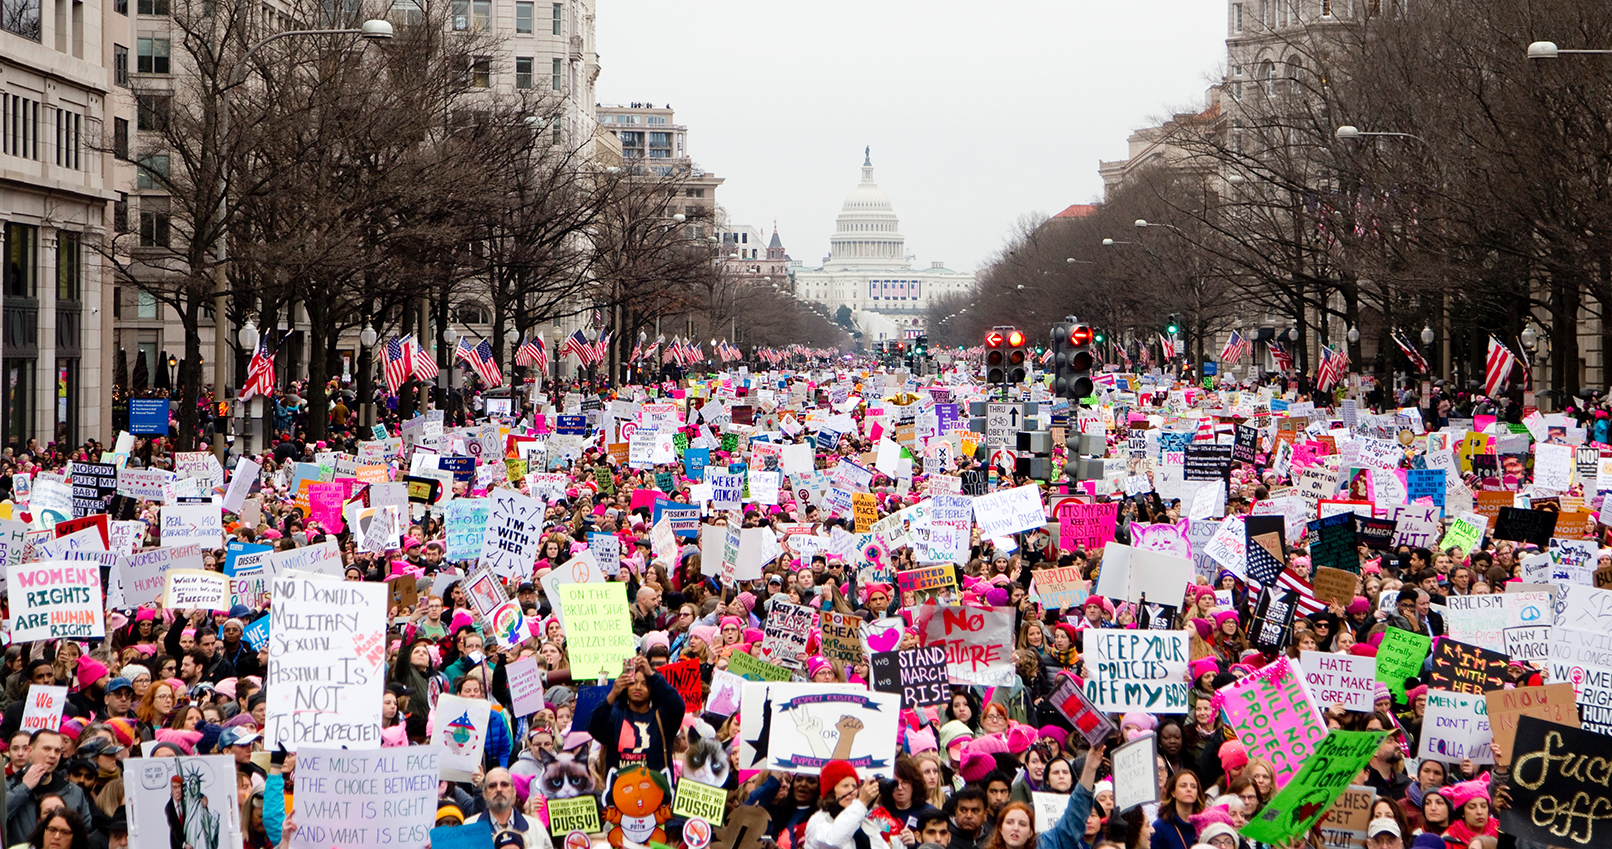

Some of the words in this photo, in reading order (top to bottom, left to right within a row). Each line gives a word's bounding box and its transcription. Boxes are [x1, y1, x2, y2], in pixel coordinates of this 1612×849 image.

[988, 428, 1005, 436] OBEY
[1129, 440, 1145, 449] LIVES
[1234, 443, 1255, 453] OVARY
[176, 452, 207, 462] NASTY
[1234, 451, 1254, 461] ACTION
[1360, 454, 1395, 469] TREASON
[1431, 454, 1448, 465] YES
[1577, 449, 1598, 463] NO!
[73, 464, 114, 476] NOBODY
[177, 462, 209, 471] WOMEN
[359, 469, 385, 477] WOMEN
[73, 476, 96, 486] PUTS
[99, 478, 116, 488] MY
[712, 475, 734, 486] WE'RE
[1303, 469, 1338, 483] ABORTION
[73, 488, 98, 497] BABY
[73, 498, 105, 509] MAKER
[932, 496, 946, 506] THE
[932, 509, 945, 518] THE
[1083, 505, 1093, 516] MY
[1097, 505, 1117, 516] BODY
[202, 516, 215, 526] 140
[448, 515, 488, 525] STORM
[506, 517, 525, 531] I'M
[983, 520, 1012, 534] HUMAN
[1018, 510, 1044, 526] RIGHT
[1454, 518, 1481, 538] PUSSIES
[498, 526, 528, 545] WITH
[916, 527, 930, 541] my
[932, 531, 952, 548] Body
[1060, 526, 1110, 536] LEGISLATION
[1364, 528, 1393, 536] MARCH
[1507, 530, 1536, 541] VOTE
[498, 539, 523, 555] HER
[915, 543, 928, 556] my
[65, 551, 120, 565] DIVERSITY
[126, 550, 167, 568] WOMEN'S
[170, 544, 200, 560] RIGHTS
[17, 568, 98, 588] WOMEN'S
[872, 568, 893, 583] World
[907, 568, 944, 580] UNITED
[921, 576, 953, 587] STAND
[1034, 568, 1080, 586] DISPUTIN
[135, 576, 166, 592] HUMAN
[230, 580, 267, 594] EQUAL
[1051, 584, 1066, 593] THIS
[27, 587, 90, 608] RIGHTS
[569, 588, 590, 600] ON
[594, 589, 610, 599] THE
[1041, 590, 1088, 609] ELECTION
[1267, 586, 1289, 612] YES
[1516, 593, 1543, 601] LOVE
[564, 604, 599, 615] BRIGHT
[603, 604, 624, 615] SIDE
[772, 600, 792, 613] KEEP
[792, 605, 812, 619] YOUR
[1449, 596, 1502, 609] RACISM
[15, 613, 48, 631] ARE
[51, 611, 95, 625] HUMAN
[272, 607, 358, 632] MILITARY
[574, 620, 589, 631] NO
[594, 619, 621, 631] MORE
[825, 612, 860, 626] DON'T
[943, 608, 984, 636] NO
[50, 624, 91, 637] RIGHTS
[247, 624, 268, 641] WE
[1507, 631, 1534, 642] WHY
[270, 633, 342, 657] SEXUAL
[355, 631, 383, 657] MEANS
[569, 636, 606, 648] GRIZZLY
[610, 636, 632, 647] BEARS
[1097, 634, 1139, 660] KEEP
[1141, 635, 1185, 662] YOUR
[367, 646, 384, 667] NO
[823, 649, 862, 663] SCHOOLS
[899, 647, 946, 668] STAND
[1395, 648, 1413, 660] rally
[1460, 653, 1486, 670] I'M
[269, 662, 334, 686] ASSAULT
[338, 658, 368, 685] IS
[734, 658, 762, 674] CANNOT
[756, 662, 789, 677] CLIMATE
[1098, 660, 1168, 680] POLICIES
[1320, 658, 1352, 672] HATE
[665, 664, 700, 690] UNITY
[900, 666, 948, 685] MARCH
[1455, 666, 1486, 684] WITH
[1341, 676, 1373, 692] MAKE
[36, 692, 53, 709] We
[294, 686, 344, 711] NOT
[514, 687, 540, 703] FORMATION
[792, 695, 822, 706] RESPECT
[827, 695, 867, 704] EXISTENCE
[904, 684, 951, 705] RISE
[1087, 680, 1118, 705] OFF
[1124, 683, 1162, 708] MY
[1504, 690, 1548, 709] NOW
[1428, 696, 1456, 709] MEN
[24, 713, 57, 731] won't
[1260, 677, 1286, 721] WILL
[1284, 729, 1312, 766] NOT
[1280, 673, 1324, 755] SILENCE
[1436, 717, 1469, 729] DON'T
[823, 730, 838, 740] OR
[1240, 689, 1292, 774] PROTECT
[1317, 734, 1356, 758] Protect
[298, 757, 321, 771] WE
[329, 758, 369, 773] MUST
[374, 757, 399, 773] ALL
[406, 754, 438, 771] FACE
[1117, 748, 1142, 772] WHITE
[1120, 766, 1146, 786] SILENCE
[1302, 757, 1360, 788] Planet
[298, 777, 327, 794] THE
[335, 778, 378, 795] CHOICE
[384, 775, 437, 794] BETWEEN
[304, 801, 350, 819] WHAT
[361, 801, 376, 819] IS
[384, 797, 427, 818] RIGHT
[676, 796, 721, 824] PUSSY!
[555, 813, 597, 832] PUSSY!
[294, 826, 326, 843] AND
[329, 828, 369, 844] WHAT
[377, 828, 391, 844] IS
[398, 826, 433, 842] EASY
[1322, 828, 1354, 847] STUFF
